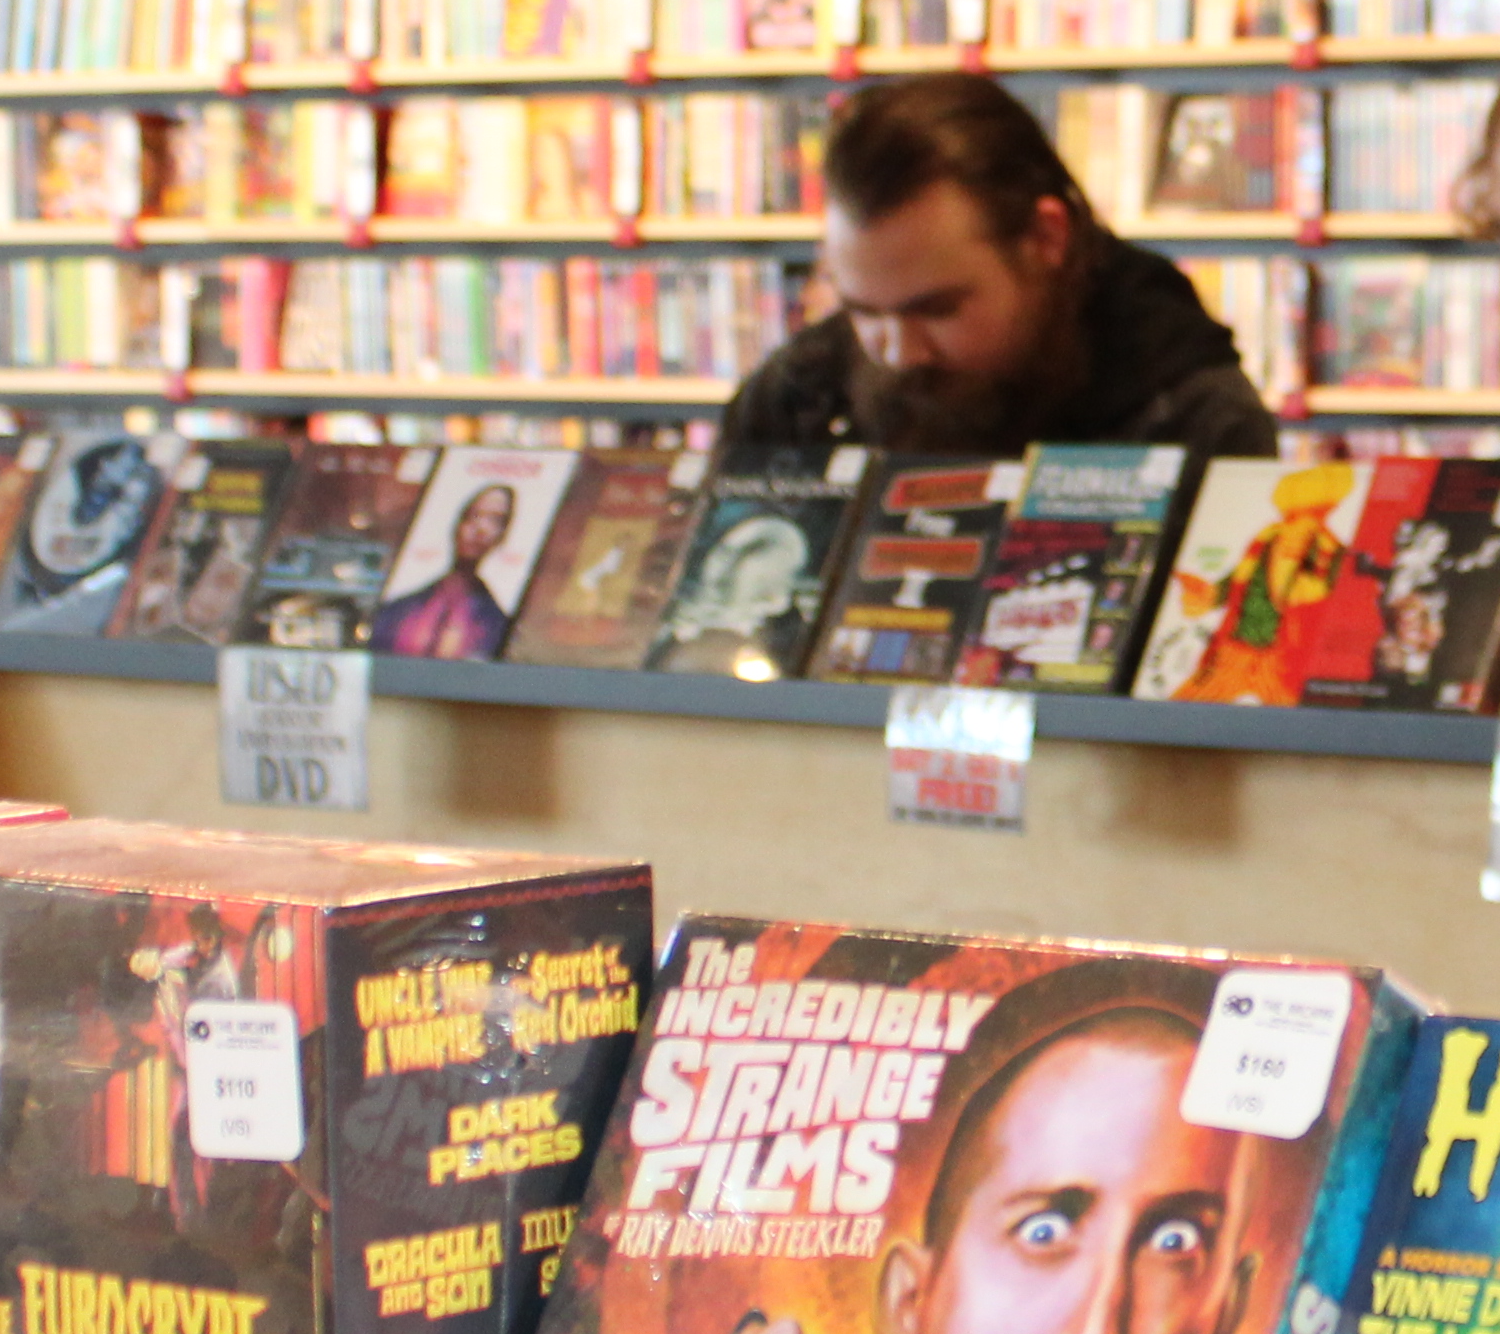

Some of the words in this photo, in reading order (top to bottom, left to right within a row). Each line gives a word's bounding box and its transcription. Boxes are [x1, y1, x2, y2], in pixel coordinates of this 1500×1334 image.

[257, 754, 329, 803] DVD
[529, 942, 604, 1002] Secret
[682, 937, 756, 987] The
[356, 970, 437, 1029] UNCLE
[558, 983, 639, 1043] Orchid
[654, 982, 998, 1053] INCREDIBLY
[365, 1028, 385, 1078] A
[386, 1012, 486, 1074] VAMPIRE
[1236, 1053, 1286, 1080] $160
[215, 1078, 256, 1098] $110
[448, 1090, 561, 1145] DARK
[629, 1036, 947, 1148] STRANGE
[429, 1122, 584, 1186] PLACES
[626, 1119, 900, 1217] FILMS
[364, 1221, 502, 1288] DRACULA
[616, 1215, 670, 1259] RAY
[668, 1215, 759, 1259] DENNIS
[756, 1215, 885, 1260] STECKLER
[1379, 1248, 1398, 1268] A
[1402, 1250, 1490, 1276] HORROR
[1371, 1270, 1472, 1325] VINNIE
